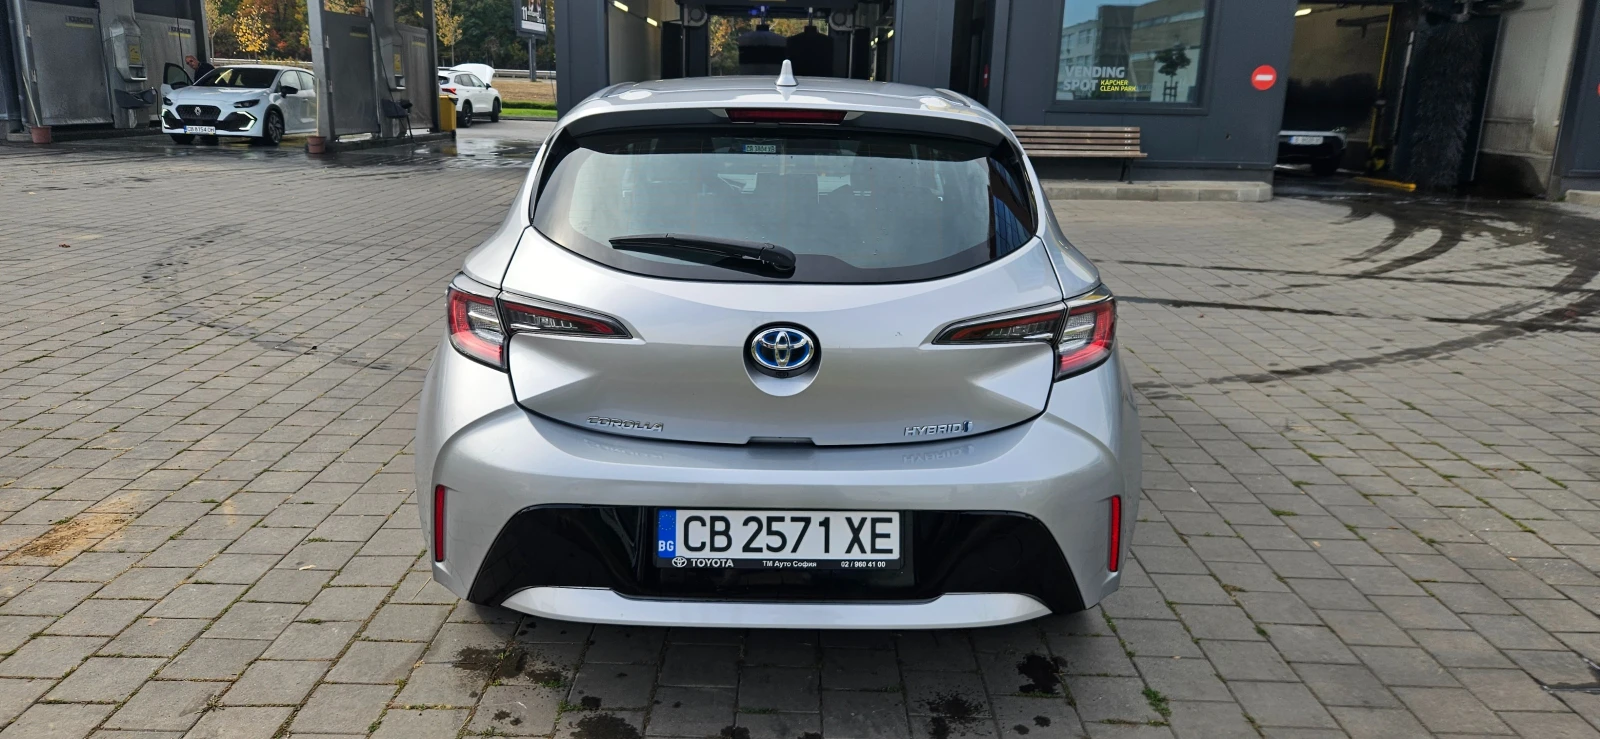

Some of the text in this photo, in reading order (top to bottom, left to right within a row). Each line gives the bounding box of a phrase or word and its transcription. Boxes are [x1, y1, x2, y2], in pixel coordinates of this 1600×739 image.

[1064, 65, 1125, 78] VENDING
[1063, 79, 1098, 91] SPOT
[587, 416, 664, 432] COROLLA
[904, 423, 962, 437] HYBRID
[683, 515, 894, 554] CB 2571 XE
[658, 540, 674, 552] BG
[690, 558, 734, 567] TOYOTA
